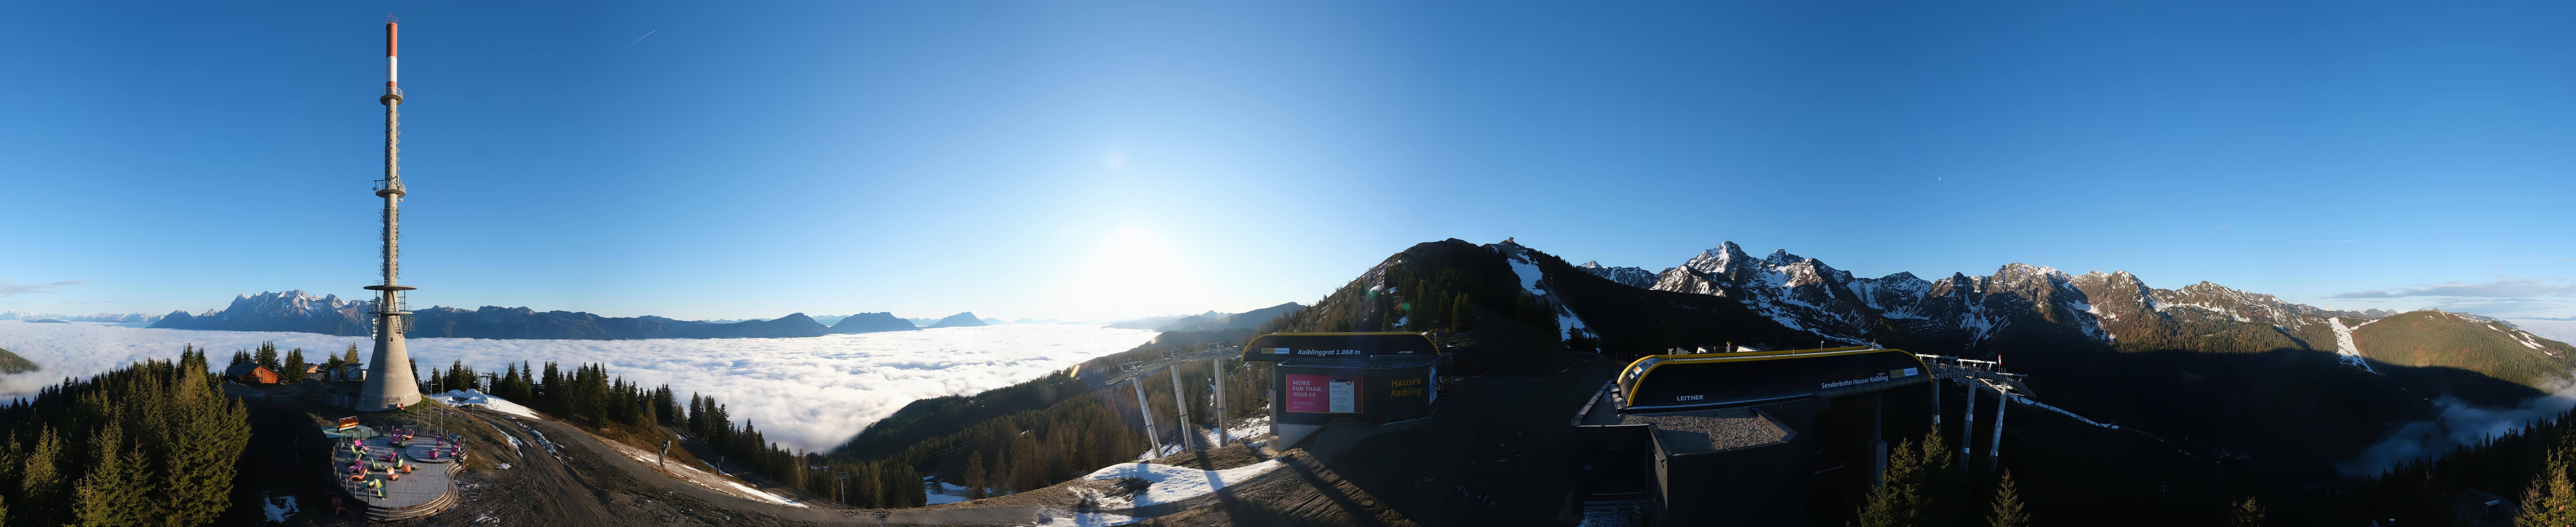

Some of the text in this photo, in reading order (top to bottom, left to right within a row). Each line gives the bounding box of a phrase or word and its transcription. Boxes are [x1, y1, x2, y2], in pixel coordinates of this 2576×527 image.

[1391, 379, 1421, 387] HAUSER
[1822, 380, 1852, 389] Senderbahn
[1391, 387, 1421, 397] Kaibling
